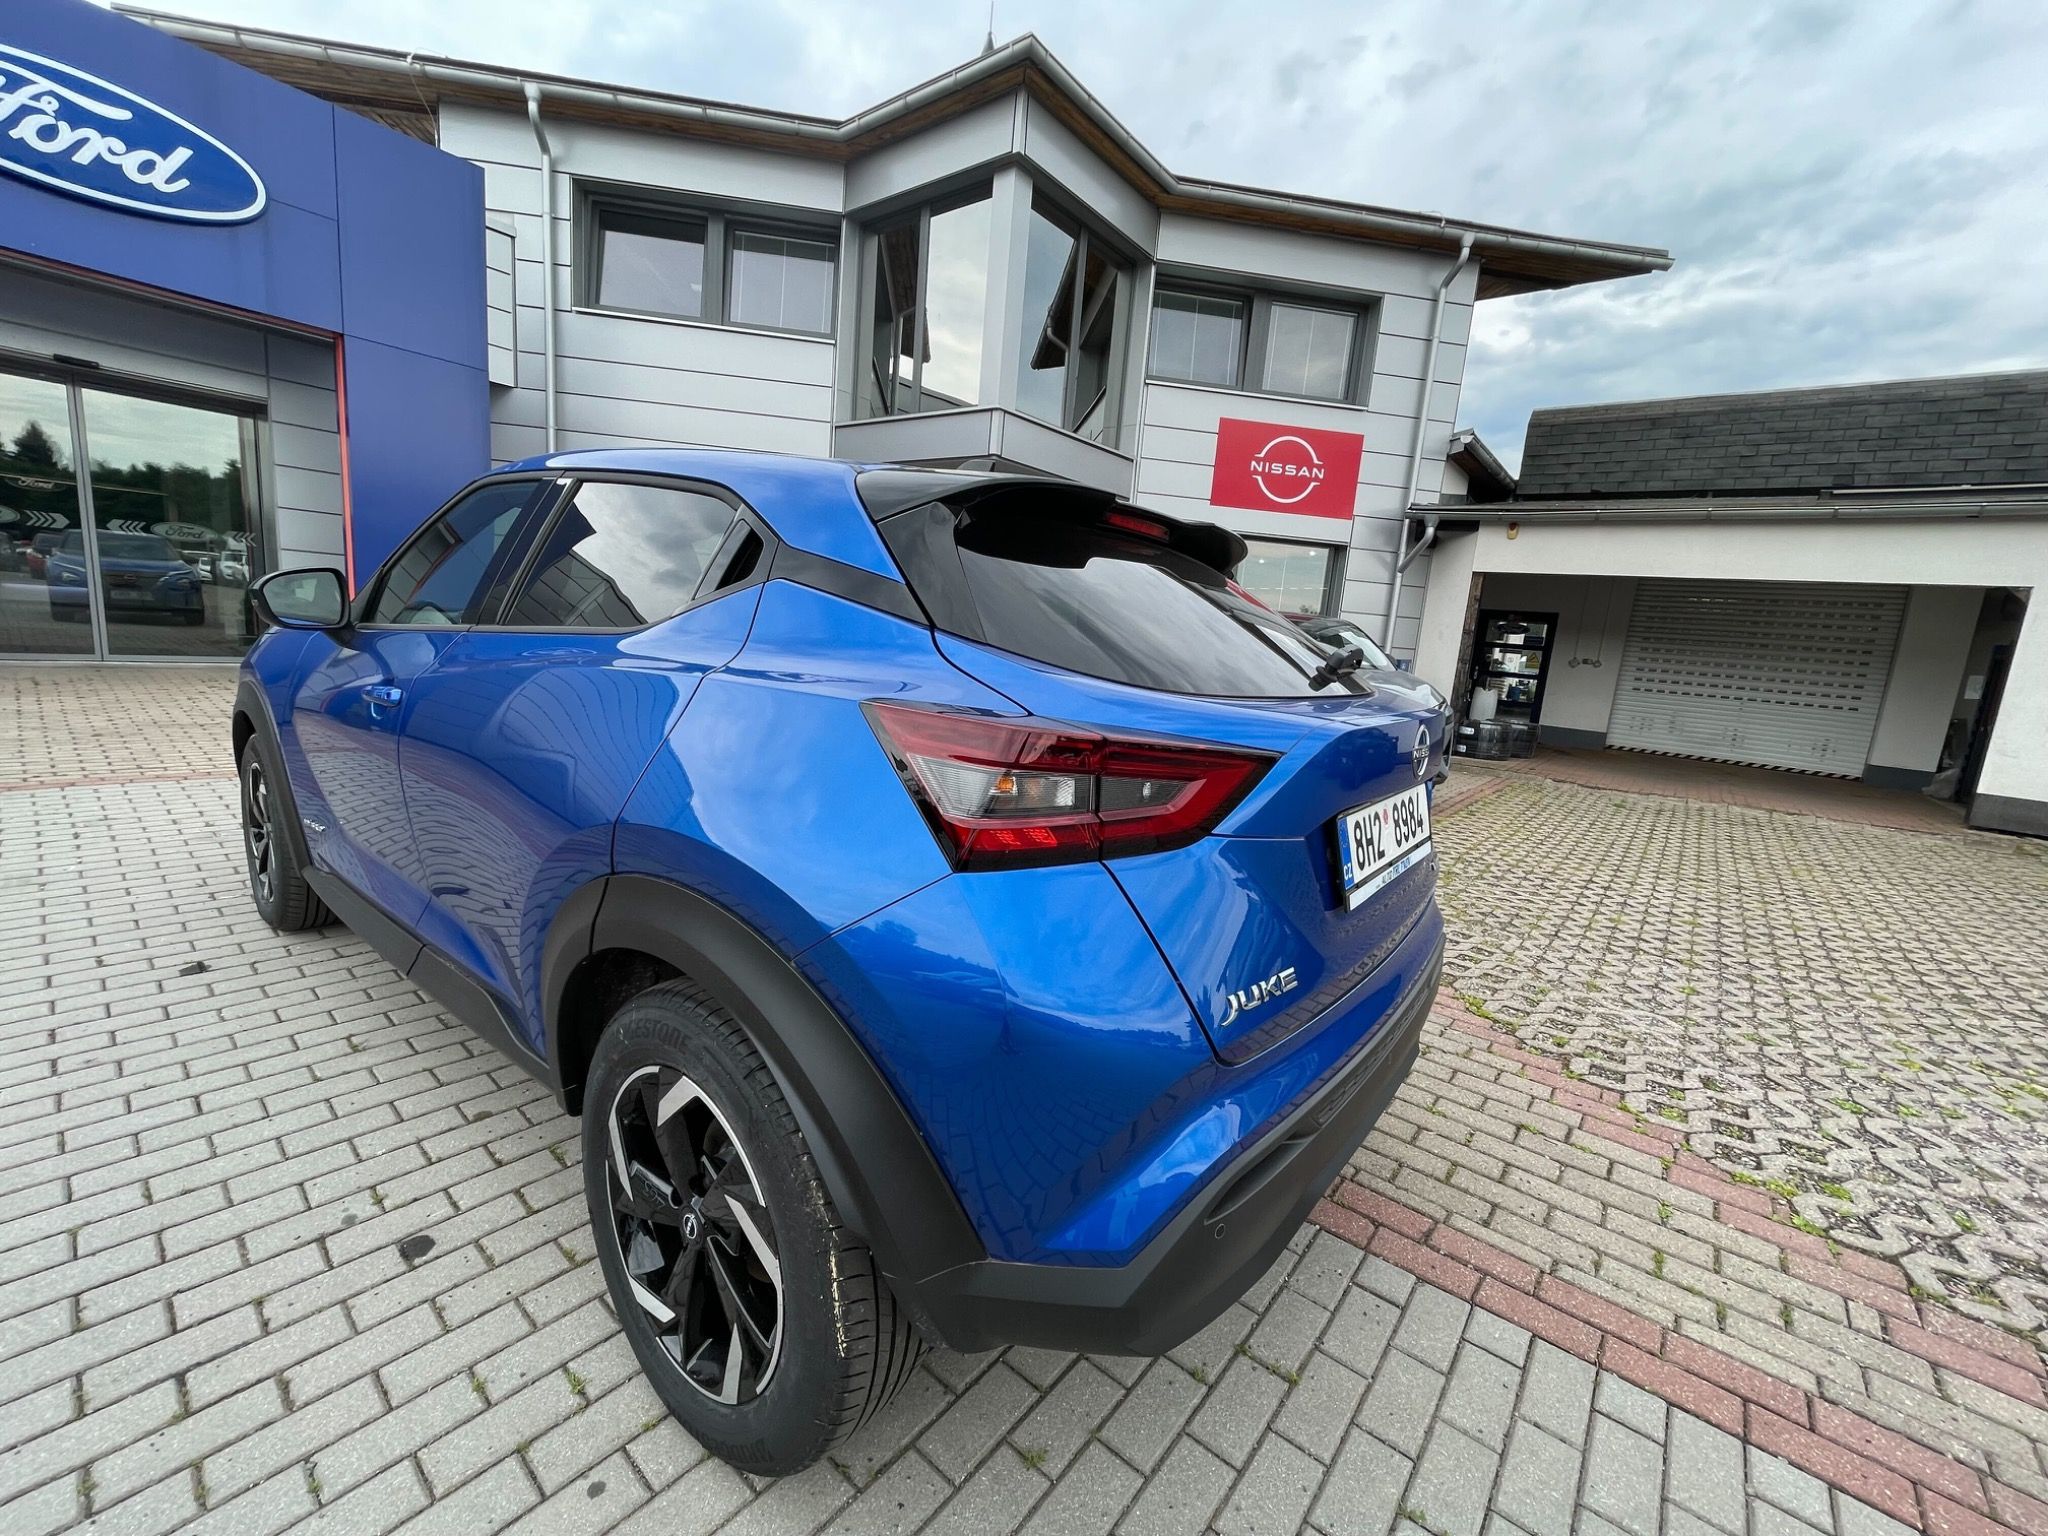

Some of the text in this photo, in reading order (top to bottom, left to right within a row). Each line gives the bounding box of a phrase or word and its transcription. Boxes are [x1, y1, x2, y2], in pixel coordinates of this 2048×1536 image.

[1250, 460, 1325, 480] NISSAN
[165, 524, 204, 539] Ford
[1353, 791, 1423, 871] 8H2 8984
[1343, 862, 1353, 881] CZ
[1220, 966, 1299, 1027] JUKE
